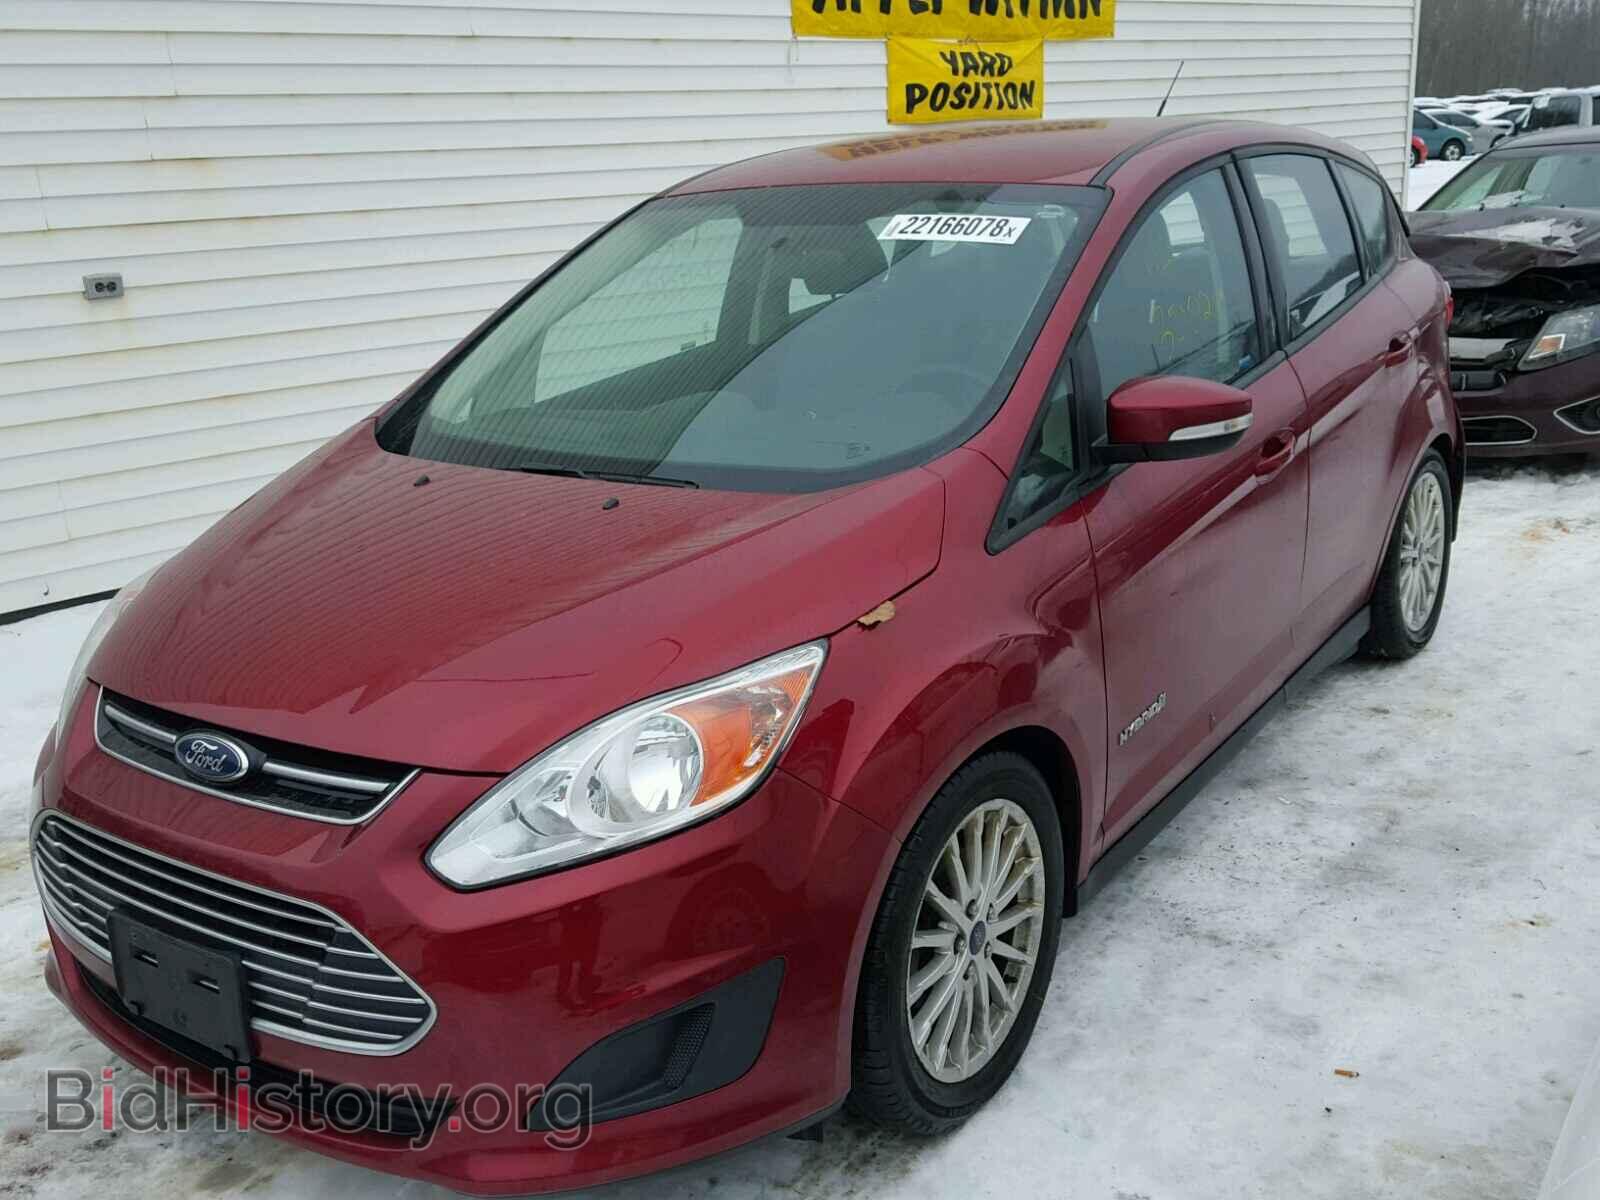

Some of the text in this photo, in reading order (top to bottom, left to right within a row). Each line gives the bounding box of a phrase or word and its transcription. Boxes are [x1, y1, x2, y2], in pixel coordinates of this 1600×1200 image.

[939, 50, 1013, 77] YARD
[905, 80, 1035, 114] POSITION
[185, 740, 227, 772] Ford
